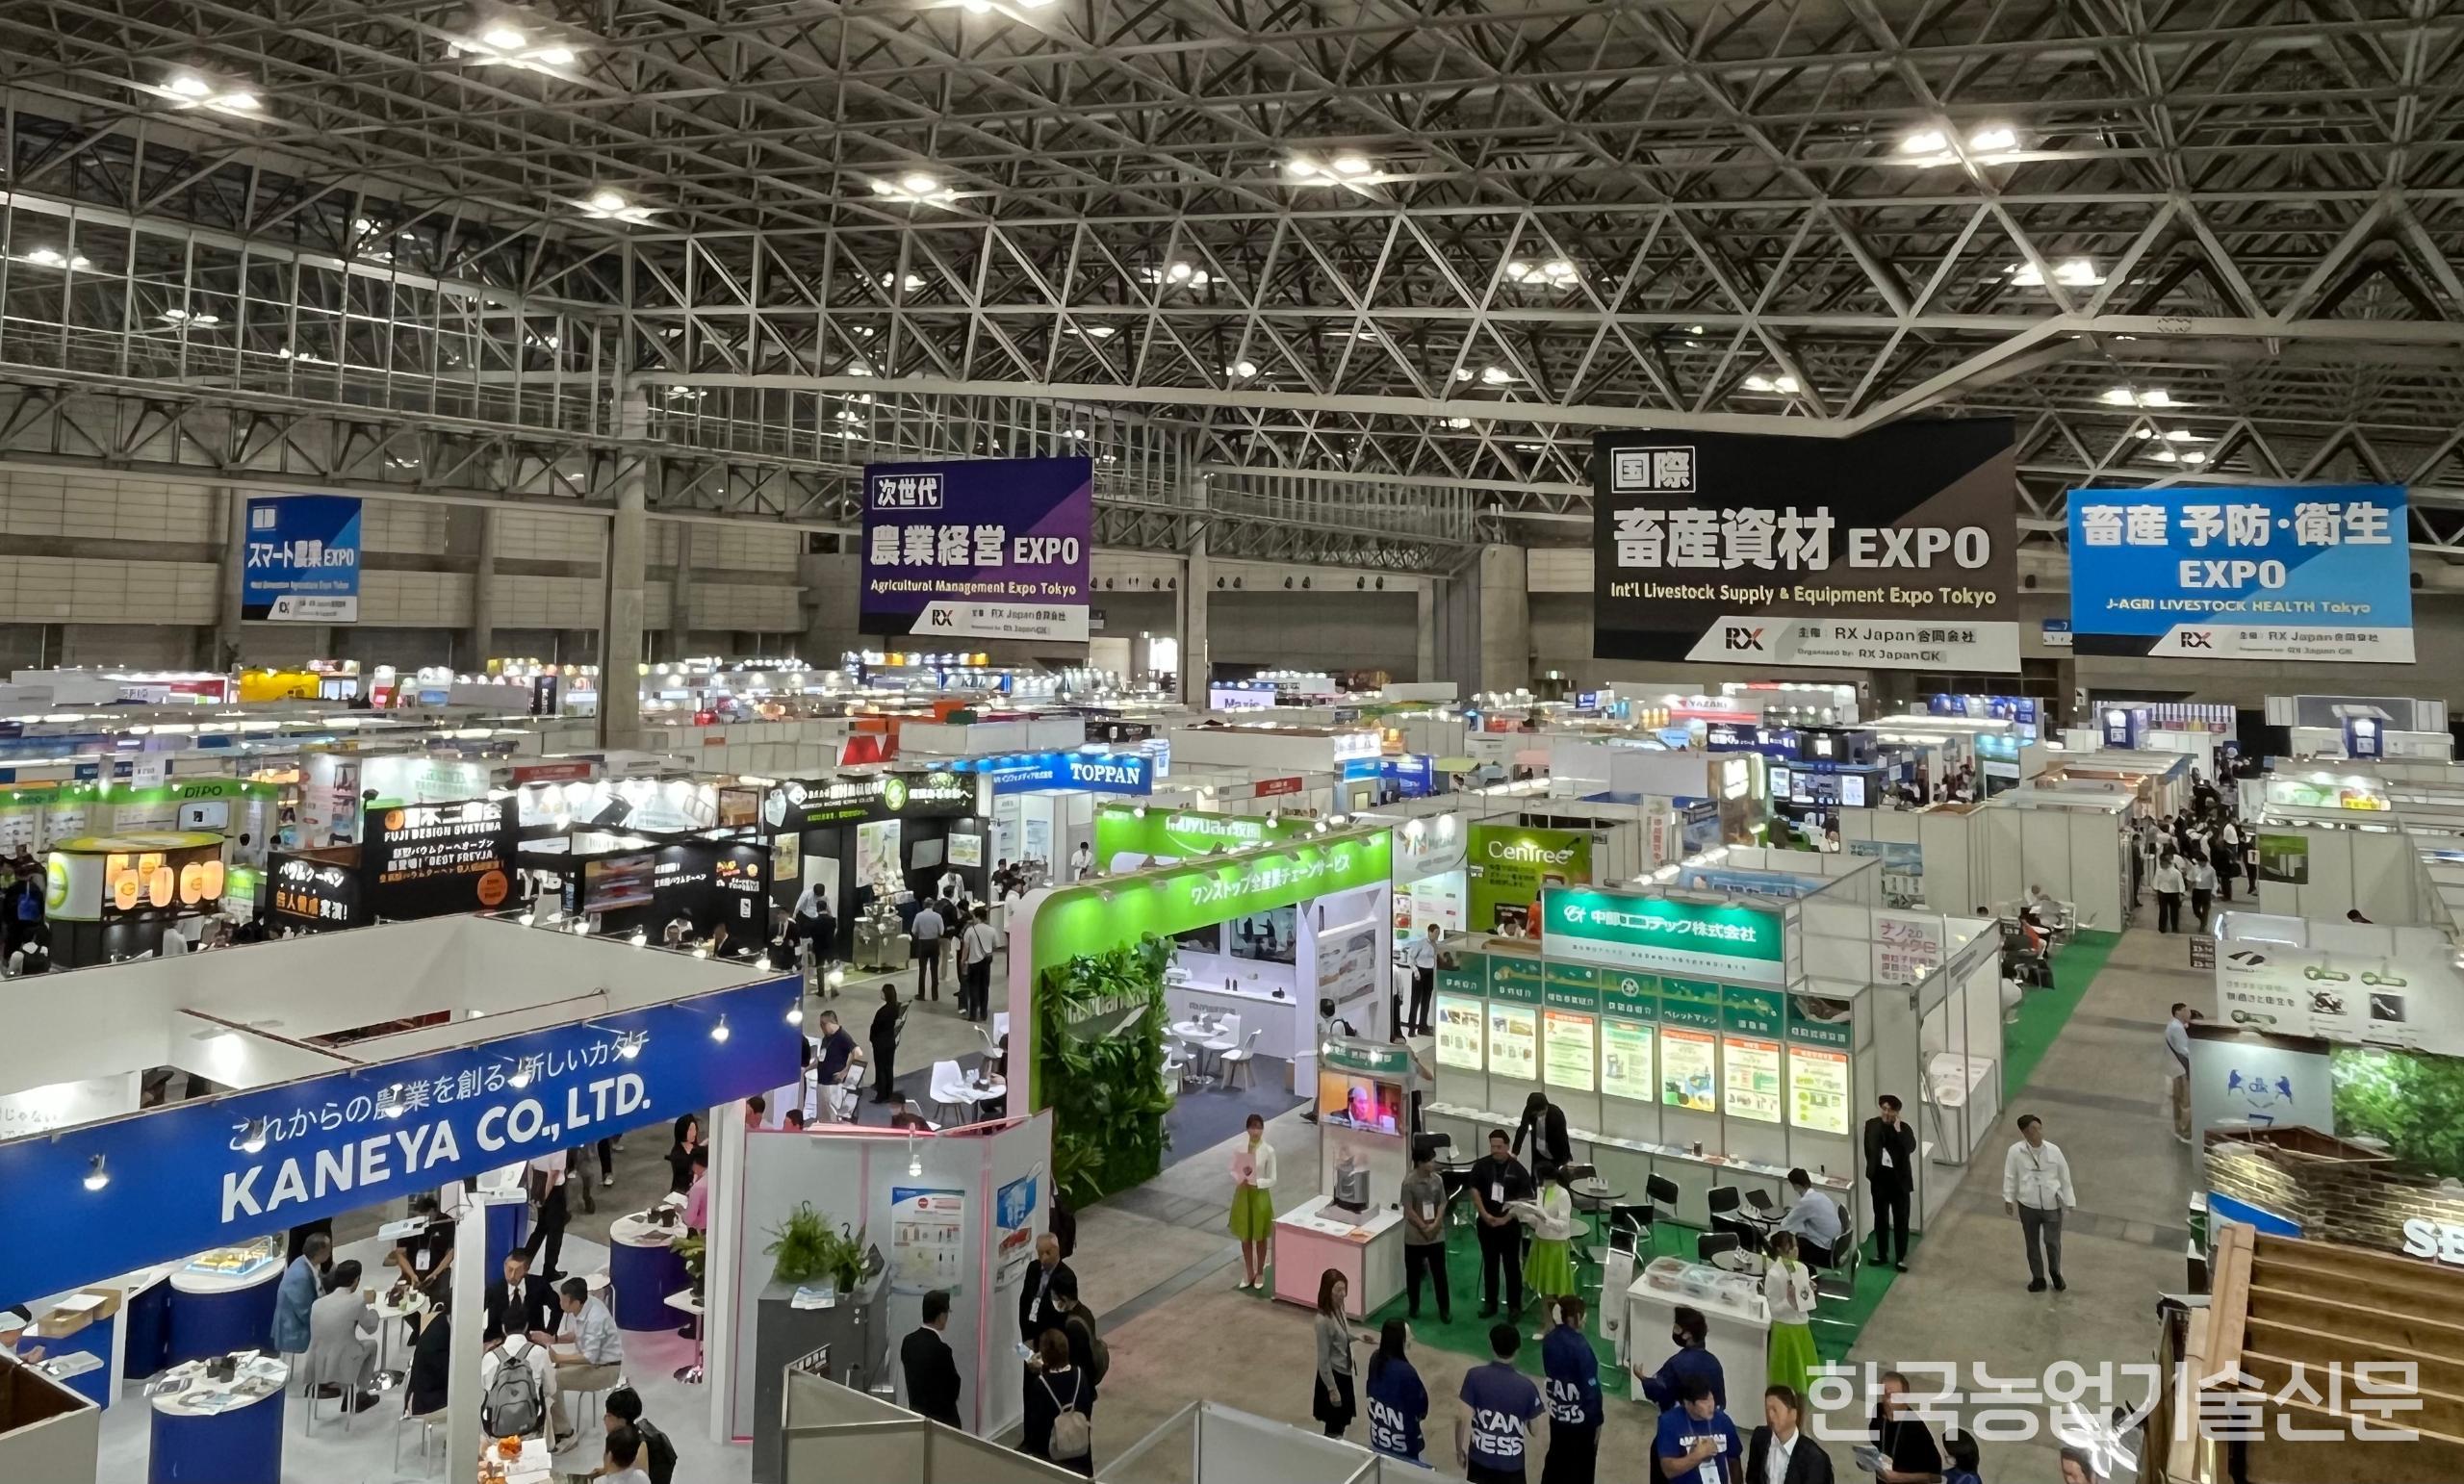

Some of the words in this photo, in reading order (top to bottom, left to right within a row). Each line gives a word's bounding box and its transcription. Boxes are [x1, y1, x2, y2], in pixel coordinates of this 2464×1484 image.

[1615, 451, 1690, 488] 国際
[878, 478, 937, 506] 次世代
[2082, 504, 2169, 547] 畜産
[2179, 501, 2392, 547] 予防・衛生
[870, 525, 1005, 566] 農業経営
[1014, 538, 1078, 564] EXPO
[1613, 506, 1835, 571] 畜産資材
[1849, 526, 1989, 569] EXPO
[323, 549, 354, 567] EXPO
[2179, 560, 2286, 589] EXPO
[871, 579, 932, 594] Agricultural
[936, 580, 1004, 596] Management
[1009, 582, 1036, 597] Expo
[1040, 583, 1076, 598] Tokyo
[1611, 582, 1639, 599] Int'l
[1645, 583, 1715, 601] Livestock
[1720, 584, 1774, 605] Supply
[1780, 586, 1790, 601] &
[1795, 585, 1884, 606] Equipment
[1890, 587, 1933, 607] Expo
[1939, 588, 1996, 607] Tokyo
[932, 609, 953, 627] RX
[2106, 599, 2154, 610] J-AGRI
[2160, 600, 2246, 612] LIVESTOCK
[2252, 601, 2314, 612] HEALTH
[2323, 601, 2371, 616] Tokyo
[1726, 627, 1764, 651] RX
[1835, 627, 1858, 640] RX
[2181, 631, 2212, 649] RX
[2269, 631, 2287, 641] RX
[1859, 650, 1876, 658] RX
[1070, 763, 1141, 784] TOPPAN
[385, 830, 409, 842] FUJI
[221, 1119, 460, 1223] KANEYA
